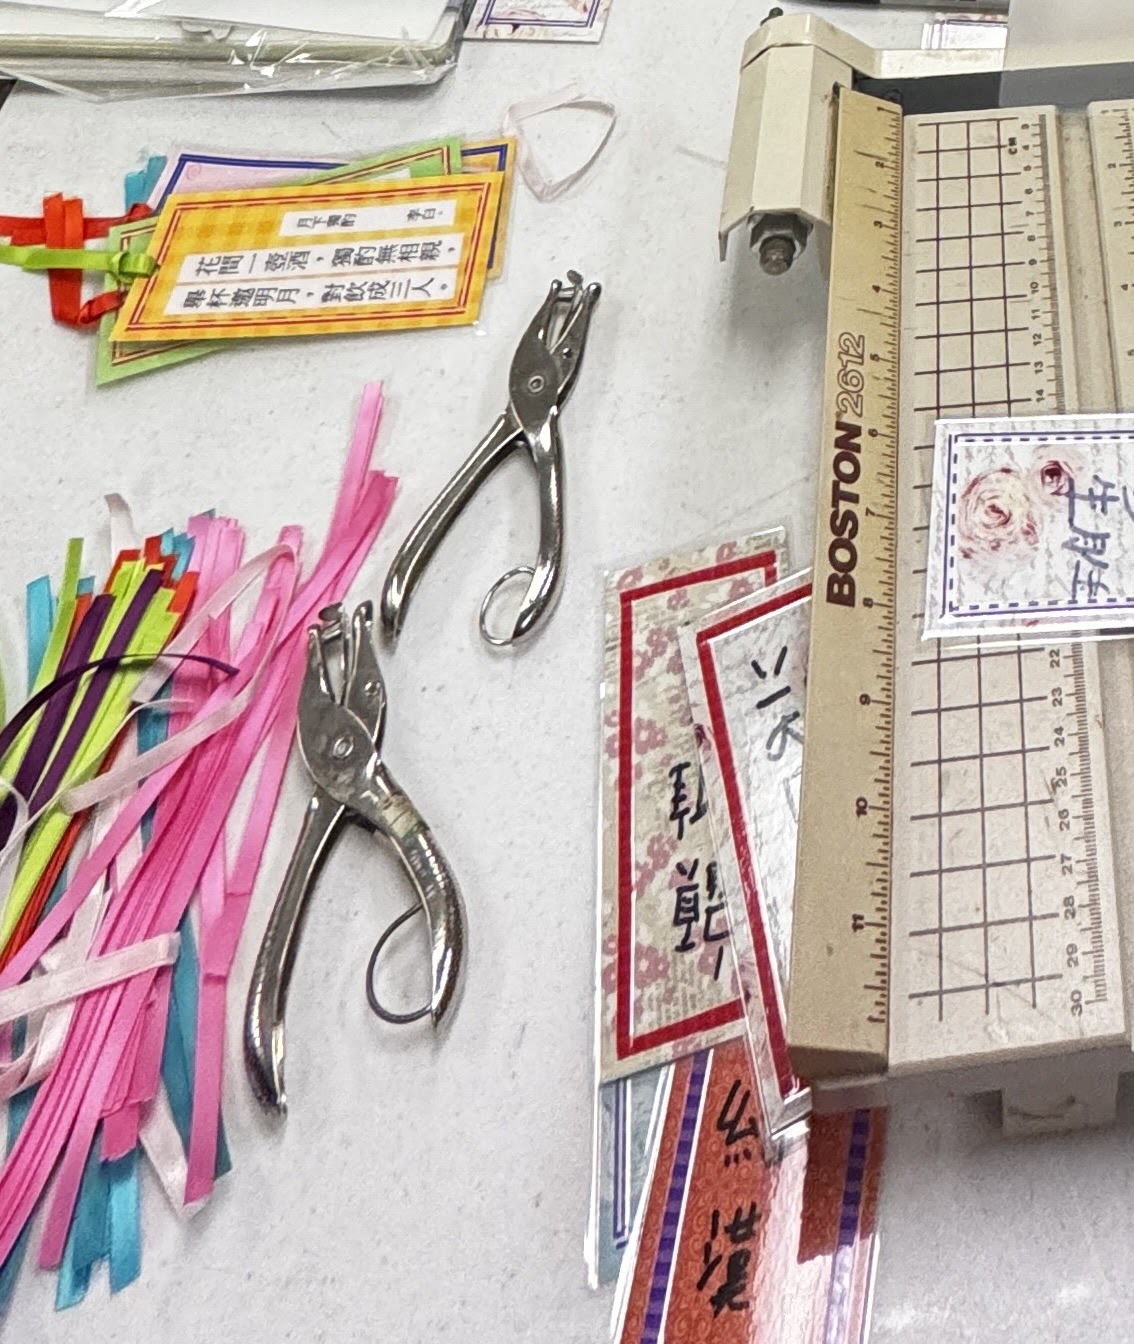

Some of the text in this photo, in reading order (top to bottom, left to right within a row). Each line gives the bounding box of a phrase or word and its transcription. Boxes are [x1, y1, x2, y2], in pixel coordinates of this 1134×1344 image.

[871, 284, 881, 294] 4
[1030, 281, 1039, 295] 10
[1031, 308, 1041, 321] 11
[1032, 332, 1042, 347] 12
[836, 332, 865, 419] 2612
[1034, 360, 1044, 375] 13
[1035, 388, 1045, 403] 14
[868, 427, 879, 438] 6
[826, 421, 863, 608] BOSTON
[863, 597, 874, 609] 8
[1049, 648, 1061, 669] 22
[859, 692, 871, 707] 9
[1052, 686, 1063, 708] 23
[1054, 725, 1065, 748] 24
[1055, 765, 1068, 788] 25
[855, 796, 868, 818] 10
[1058, 808, 1070, 832] 26
[1060, 852, 1073, 877] 27
[1063, 895, 1076, 920] 28
[852, 914, 865, 933] 11
[1066, 943, 1079, 968] 29
[1070, 989, 1083, 1016] 30
